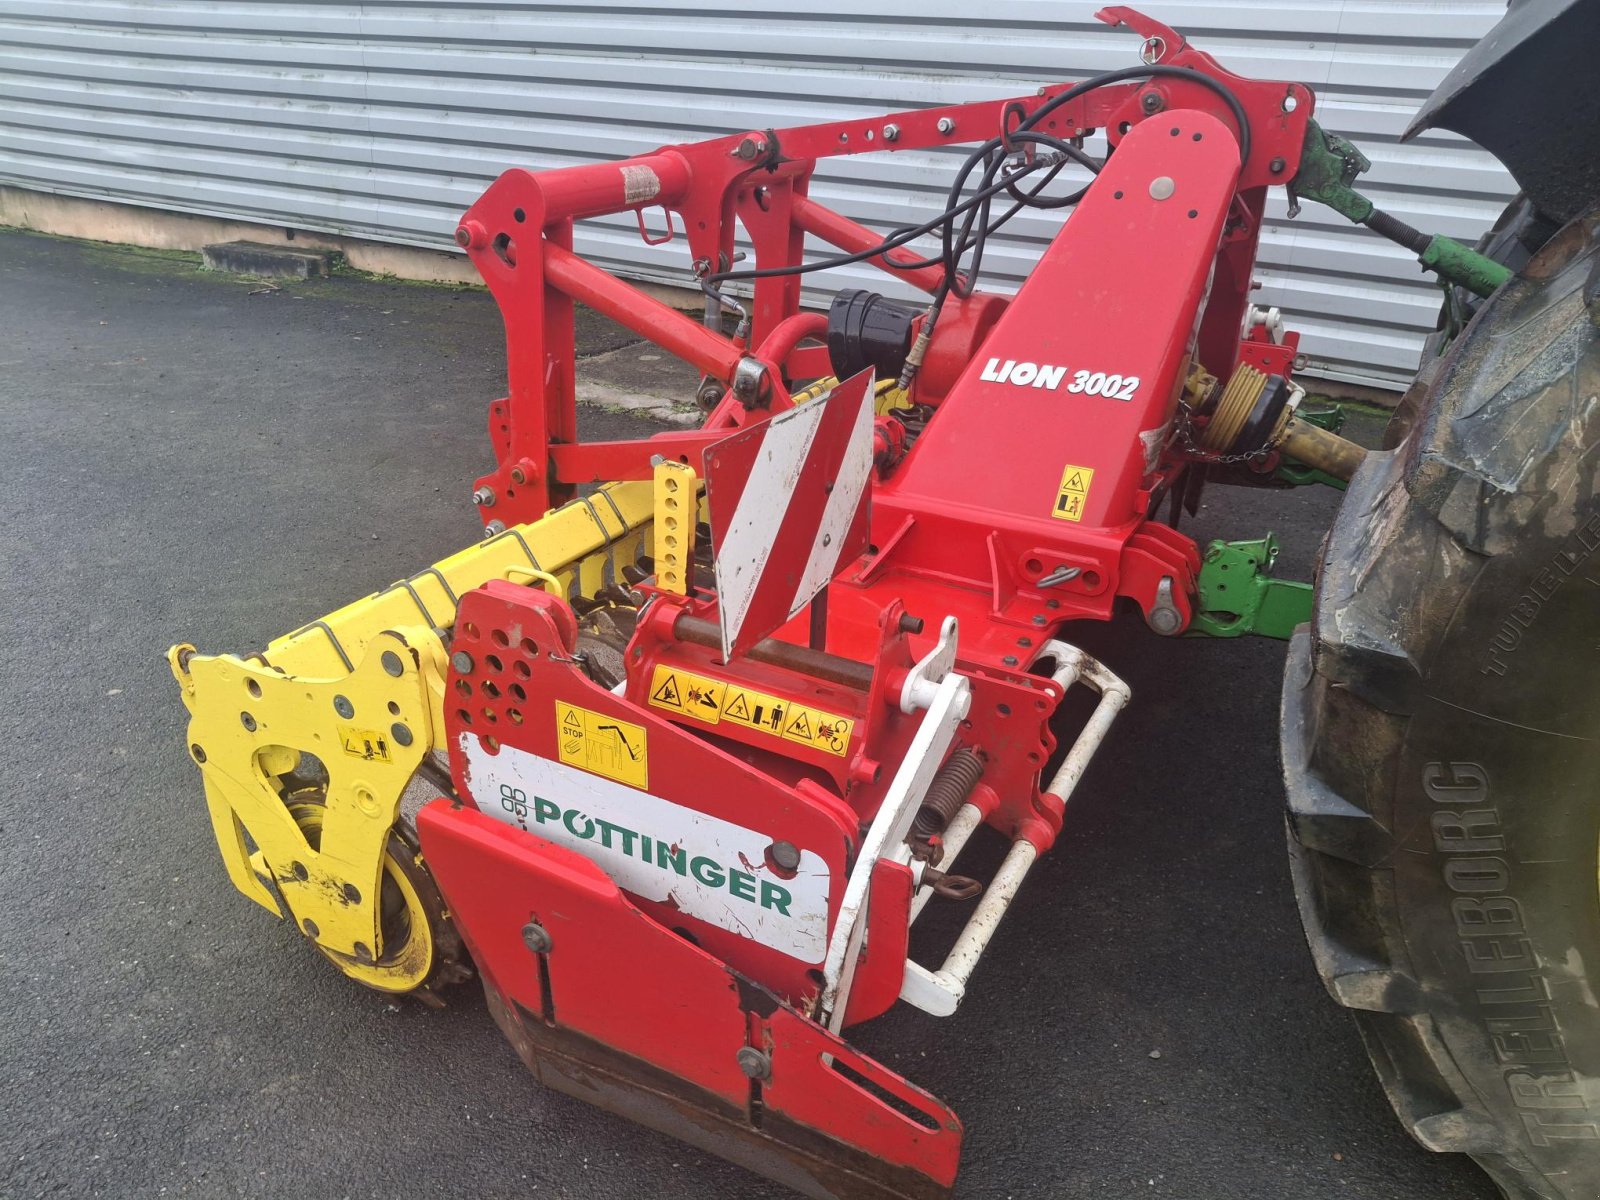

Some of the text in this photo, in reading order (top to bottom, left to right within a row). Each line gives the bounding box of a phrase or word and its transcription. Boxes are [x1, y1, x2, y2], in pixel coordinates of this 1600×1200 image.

[980, 358, 1141, 401] LION 3002
[563, 726, 583, 739] STOP
[1421, 761, 1600, 1148] TRELLEBORG
